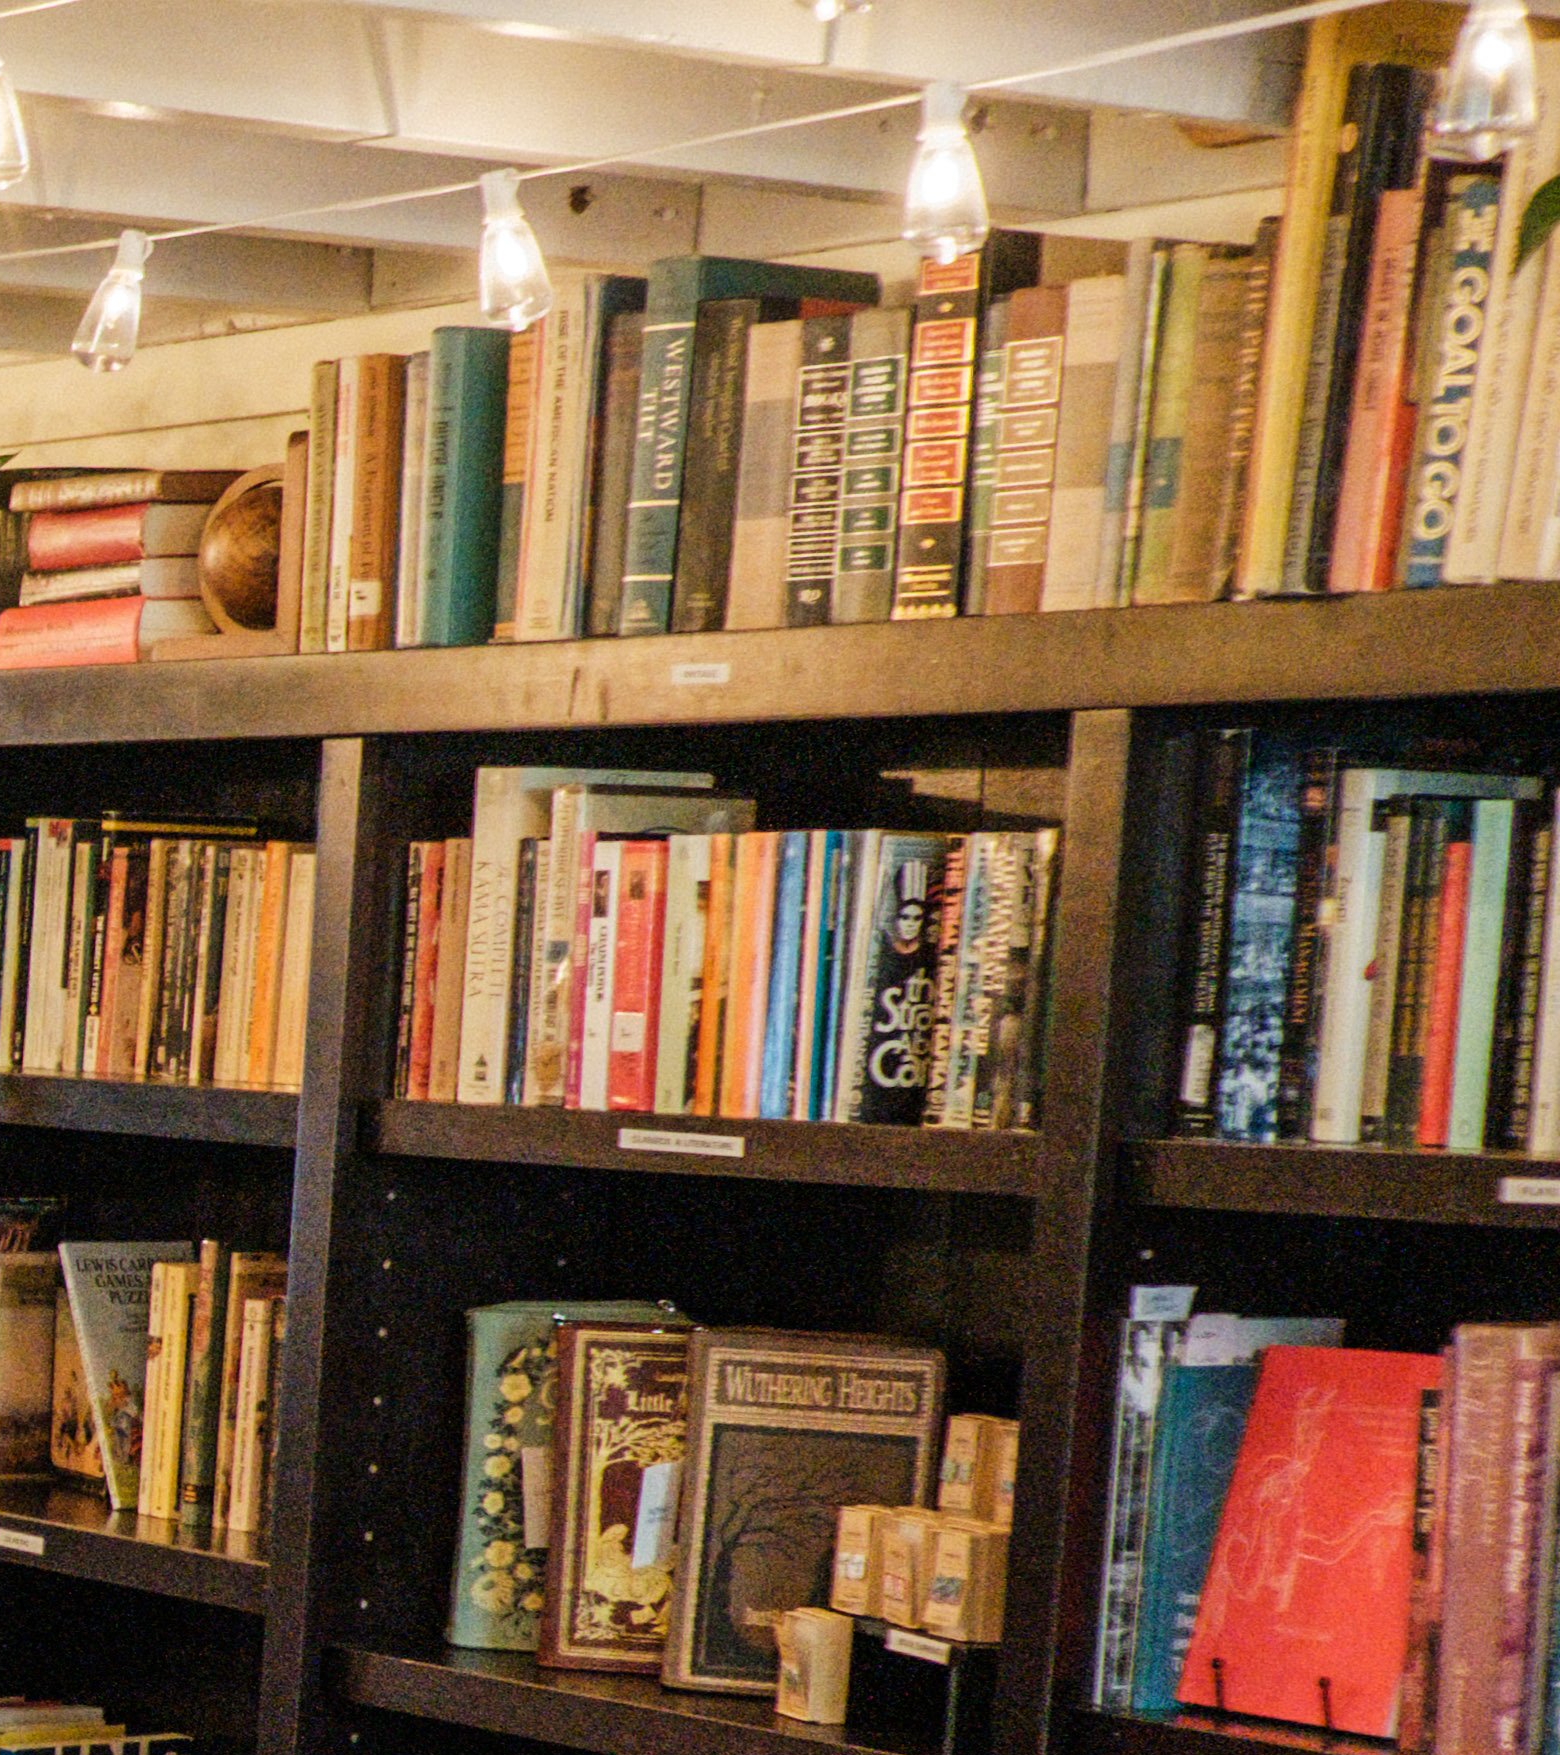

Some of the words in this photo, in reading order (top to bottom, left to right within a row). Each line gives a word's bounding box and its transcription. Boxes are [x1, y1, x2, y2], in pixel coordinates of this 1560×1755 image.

[555, 310, 569, 340] RISE
[1439, 267, 1490, 387] GOAL
[551, 366, 566, 390] THE
[547, 393, 565, 466] AMERICAN
[636, 386, 660, 442] TILT
[649, 334, 689, 492] WESTWARD
[544, 469, 561, 524] NATION
[1414, 461, 1460, 540] GO
[626, 1390, 675, 1413] Little
[725, 1365, 833, 1408] WUTHERING
[837, 1372, 919, 1412] HEIGHTS
